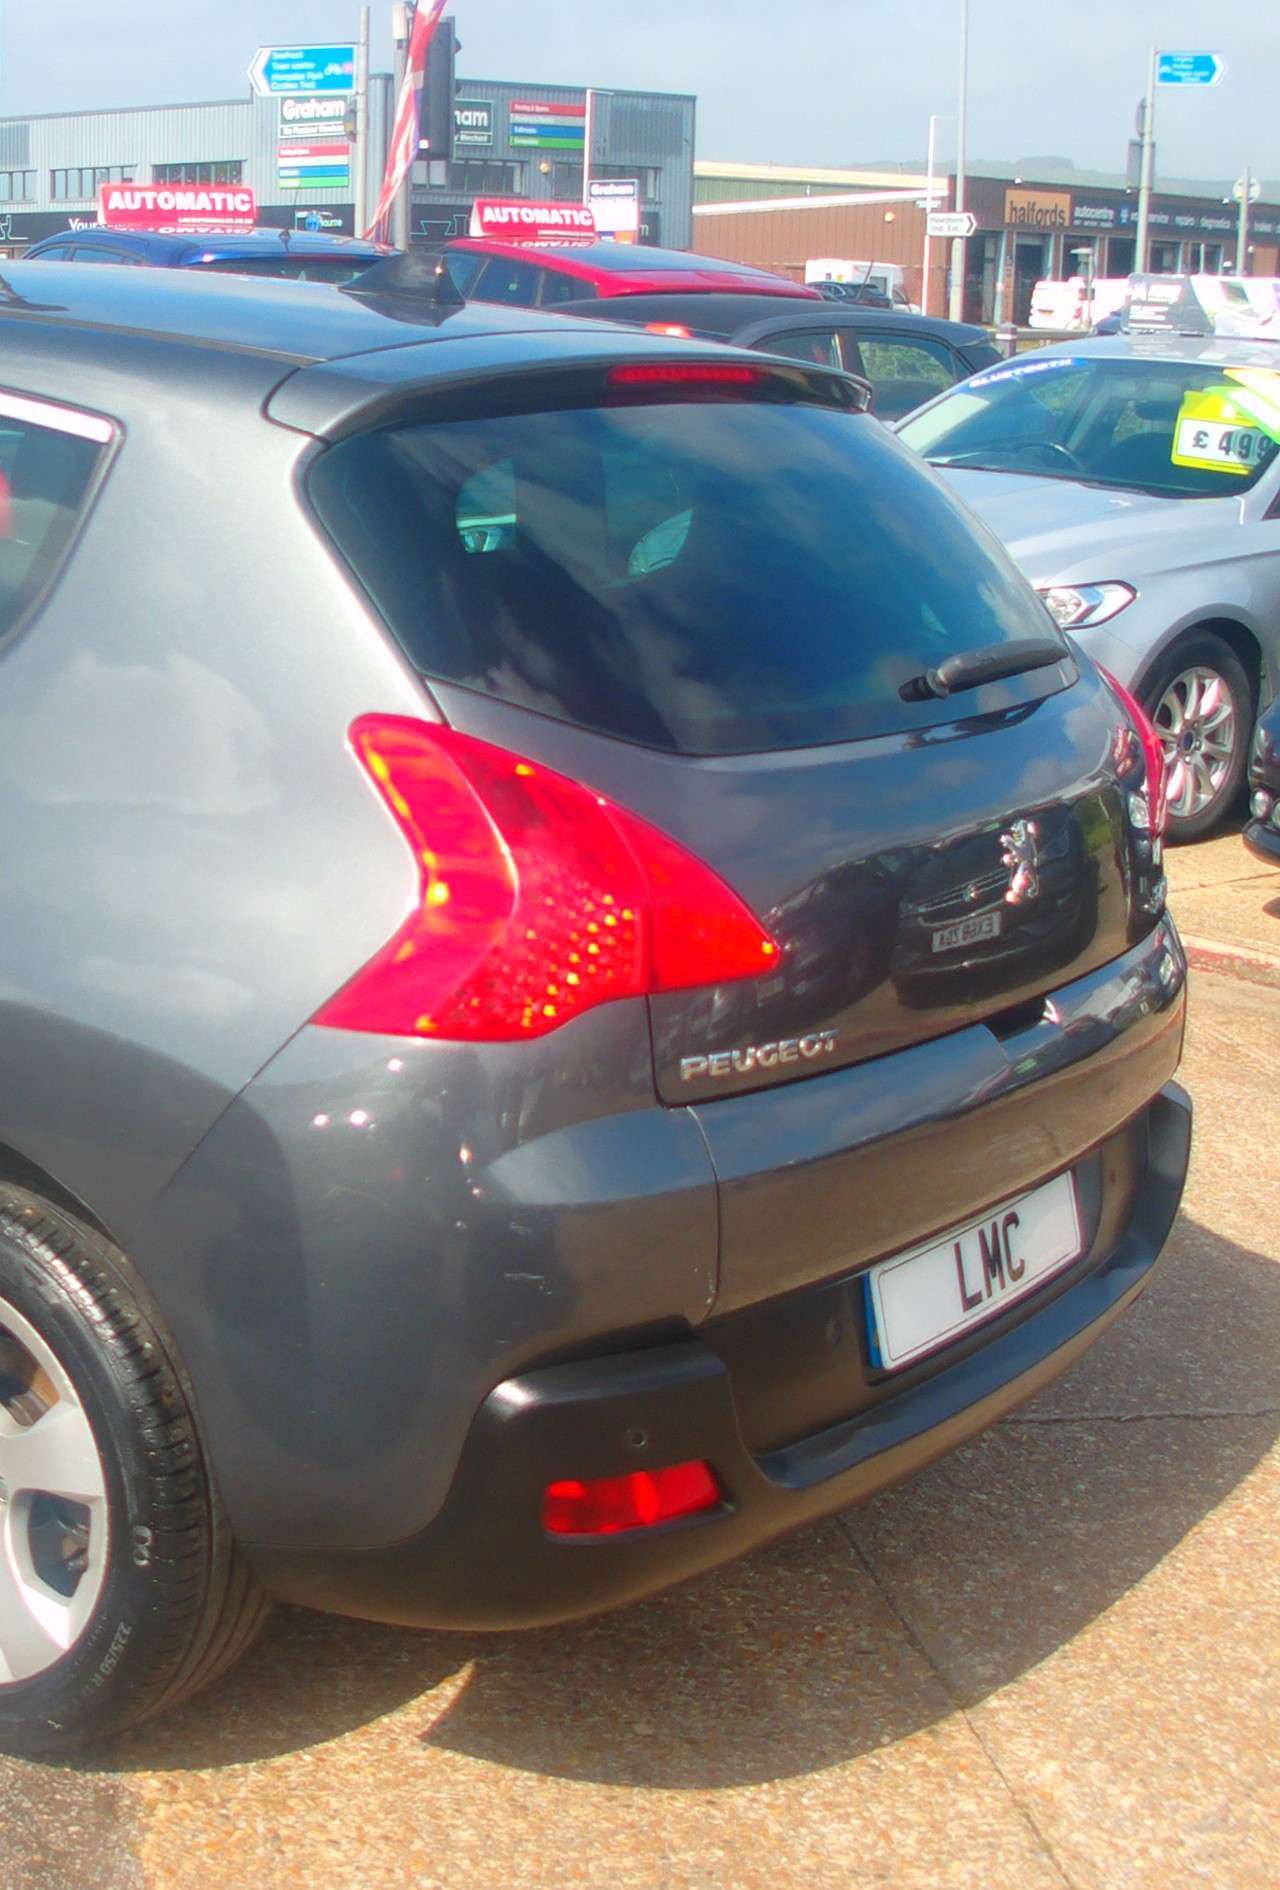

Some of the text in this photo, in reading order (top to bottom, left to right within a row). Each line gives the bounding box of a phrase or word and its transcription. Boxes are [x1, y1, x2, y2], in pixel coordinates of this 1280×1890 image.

[282, 98, 346, 120] Graham
[590, 183, 634, 197] Graham
[108, 191, 253, 213] AUTOMATIC
[483, 206, 593, 226] AUTOMATIC
[1009, 200, 1066, 227] halfords
[679, 1028, 841, 1082] PEUGEOT
[953, 1211, 1026, 1313] LMC
